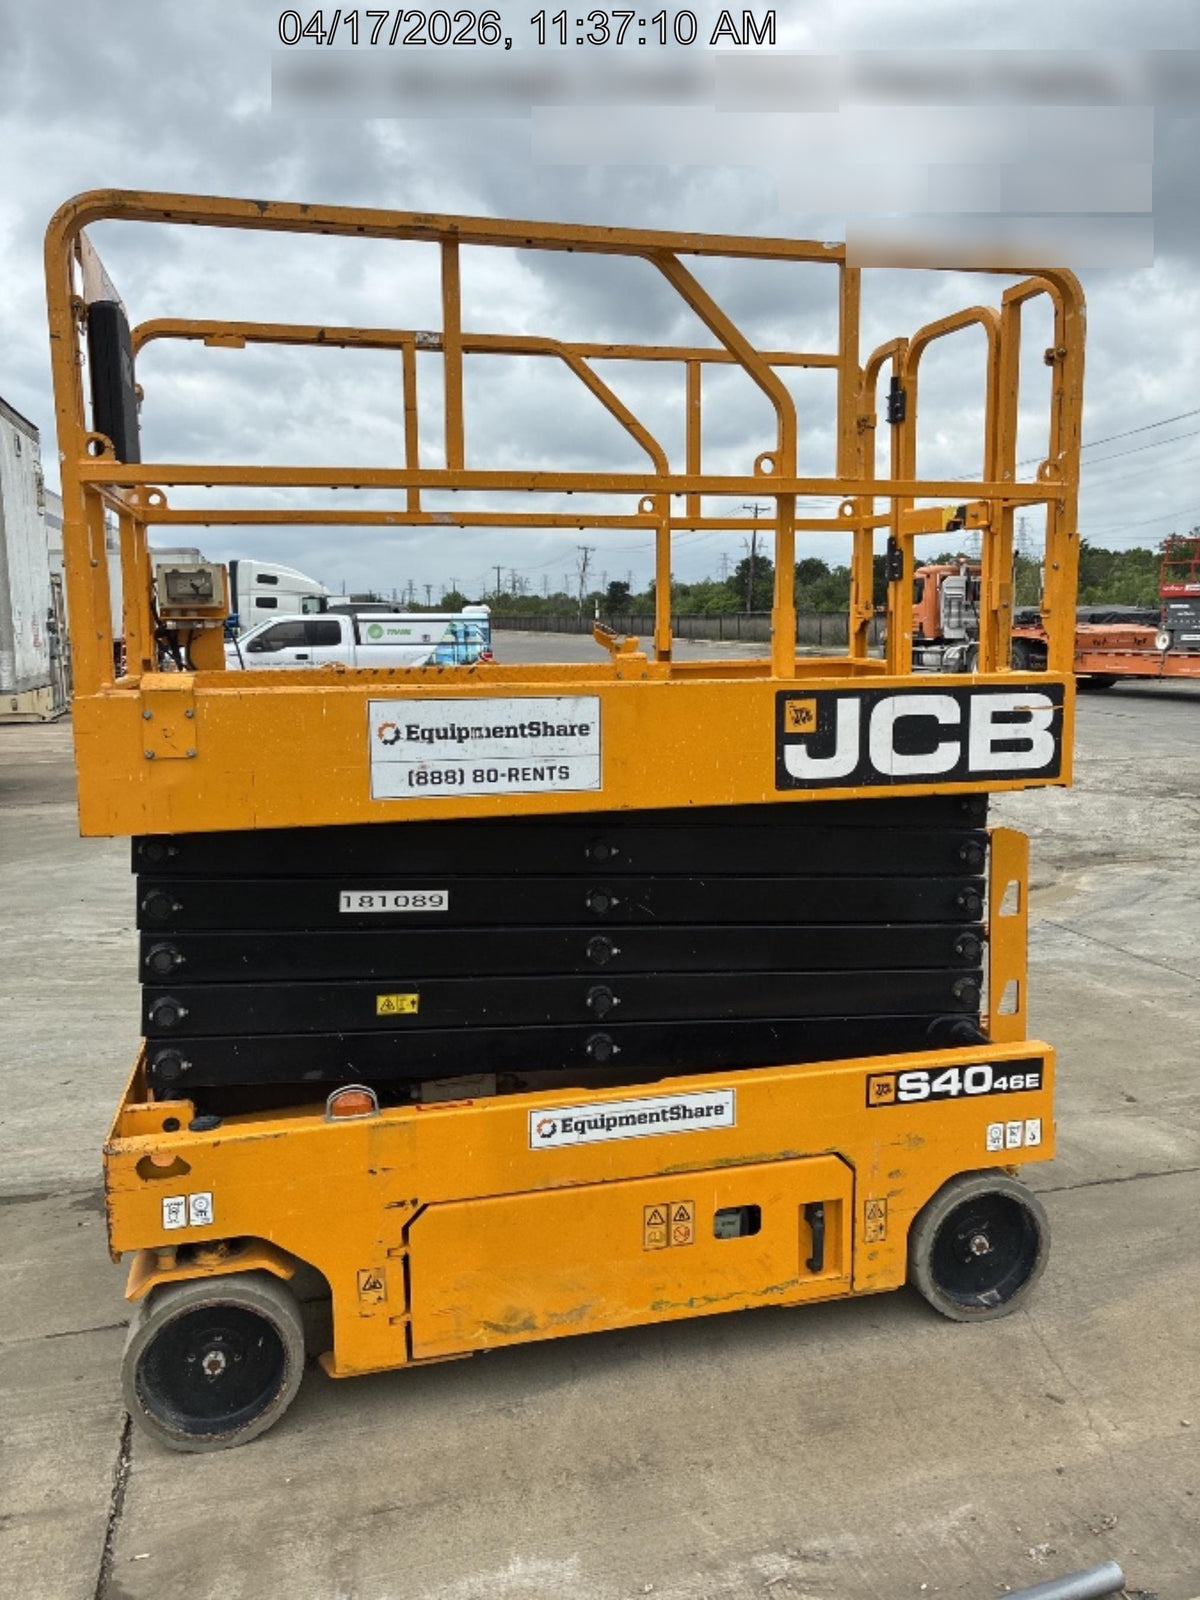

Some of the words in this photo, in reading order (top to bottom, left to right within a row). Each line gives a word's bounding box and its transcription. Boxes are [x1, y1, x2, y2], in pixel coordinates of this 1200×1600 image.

[405, 721, 590, 744] EquipmentShare
[784, 693, 1056, 780] JCB
[408, 768, 465, 787] (888)
[472, 765, 571, 783] 80-RENTS
[342, 894, 444, 908] 181089
[561, 1104, 725, 1135] EquipmentShare
